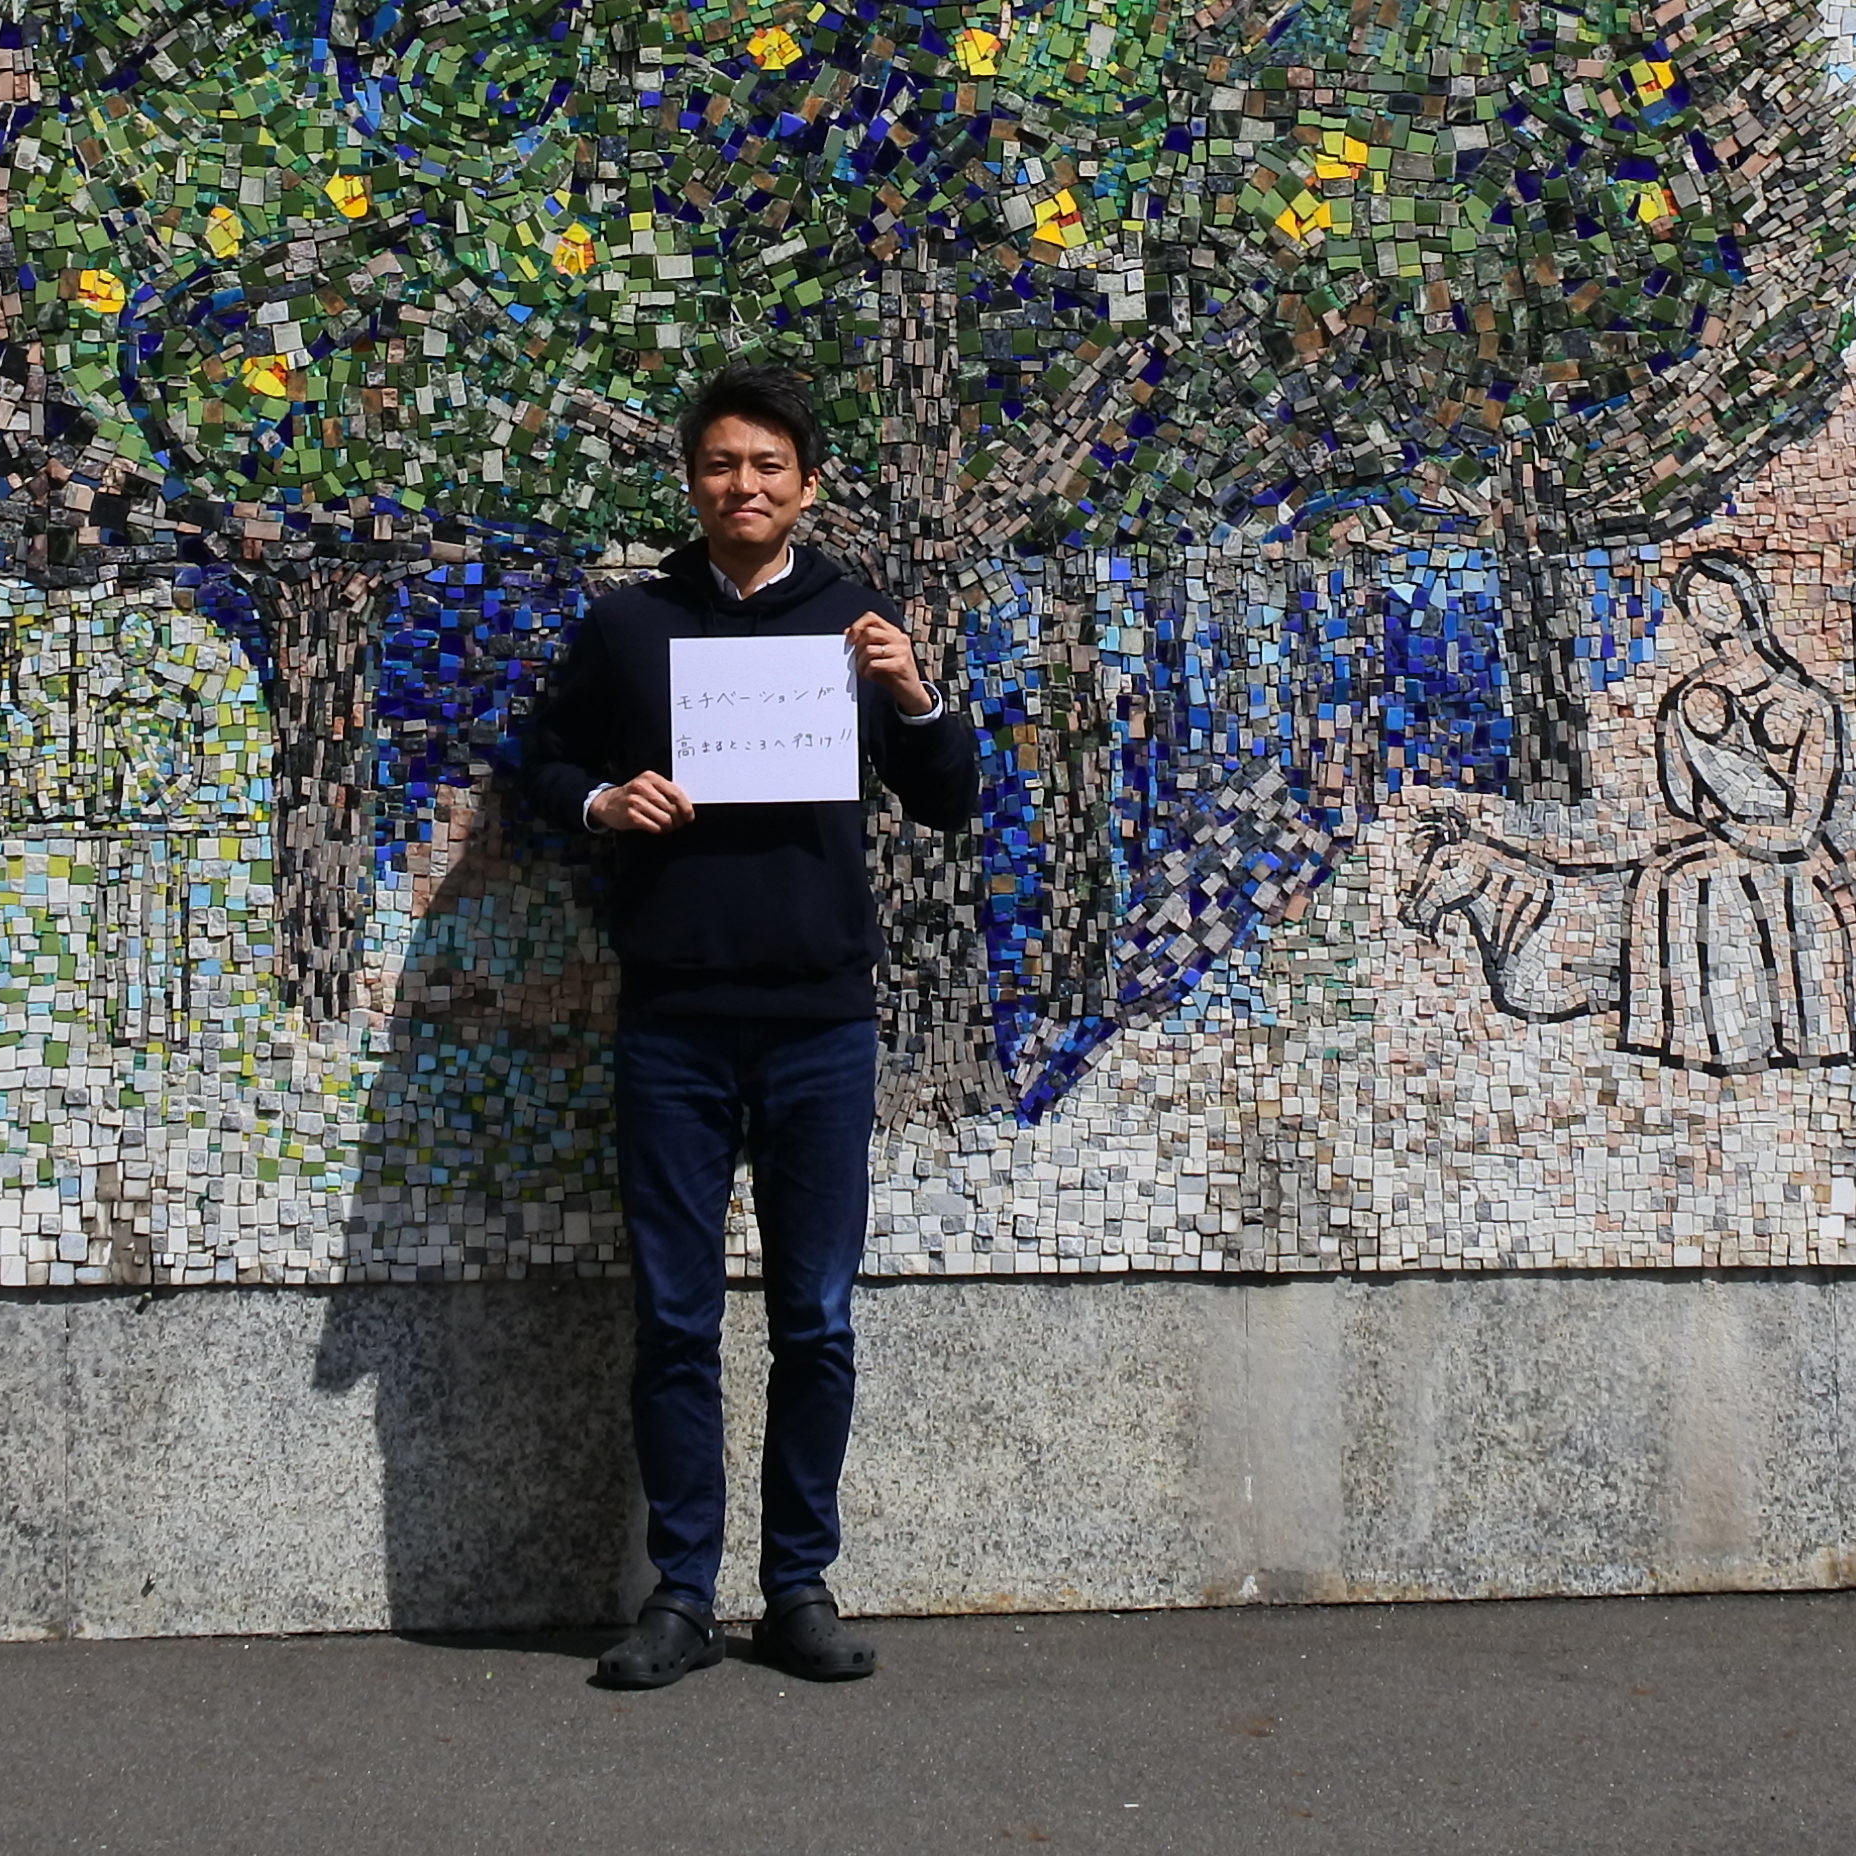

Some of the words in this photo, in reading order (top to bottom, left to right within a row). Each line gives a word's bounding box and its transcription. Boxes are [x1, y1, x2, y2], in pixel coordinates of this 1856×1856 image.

[677, 686, 834, 709] モチベーションが
